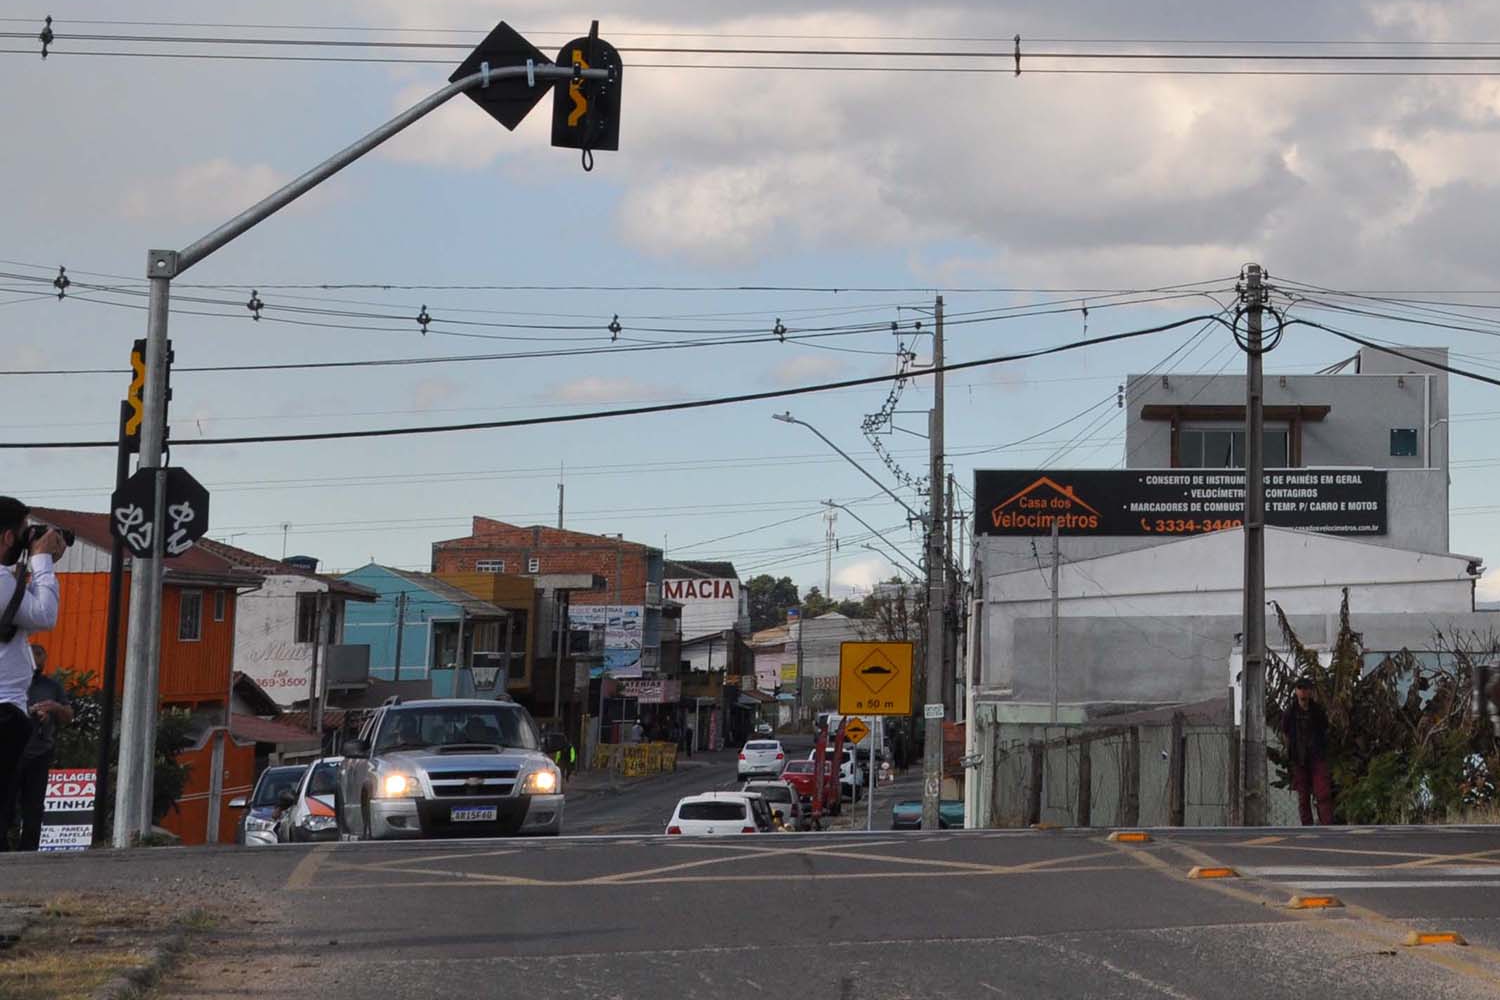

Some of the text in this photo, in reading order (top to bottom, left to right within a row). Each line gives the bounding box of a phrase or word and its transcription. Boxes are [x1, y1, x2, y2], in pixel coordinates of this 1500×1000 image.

[1146, 473, 1362, 485] CONSERTO DE INSTRUMS DE PAINÉIS EM GERAL
[1265, 488, 1318, 498] CONTAGIROS
[1019, 496, 1072, 509] Casa dos
[1130, 502, 1188, 511] MARCADORES
[1190, 502, 1201, 511] DE
[1204, 502, 1246, 511] COMBUST
[1265, 502, 1270, 511] E
[1272, 502, 1297, 511] TEMP.
[1310, 502, 1338, 511] CARRO
[1341, 502, 1346, 511] E
[1348, 501, 1378, 511] MOTOS
[868, 700, 880, 708] 50
